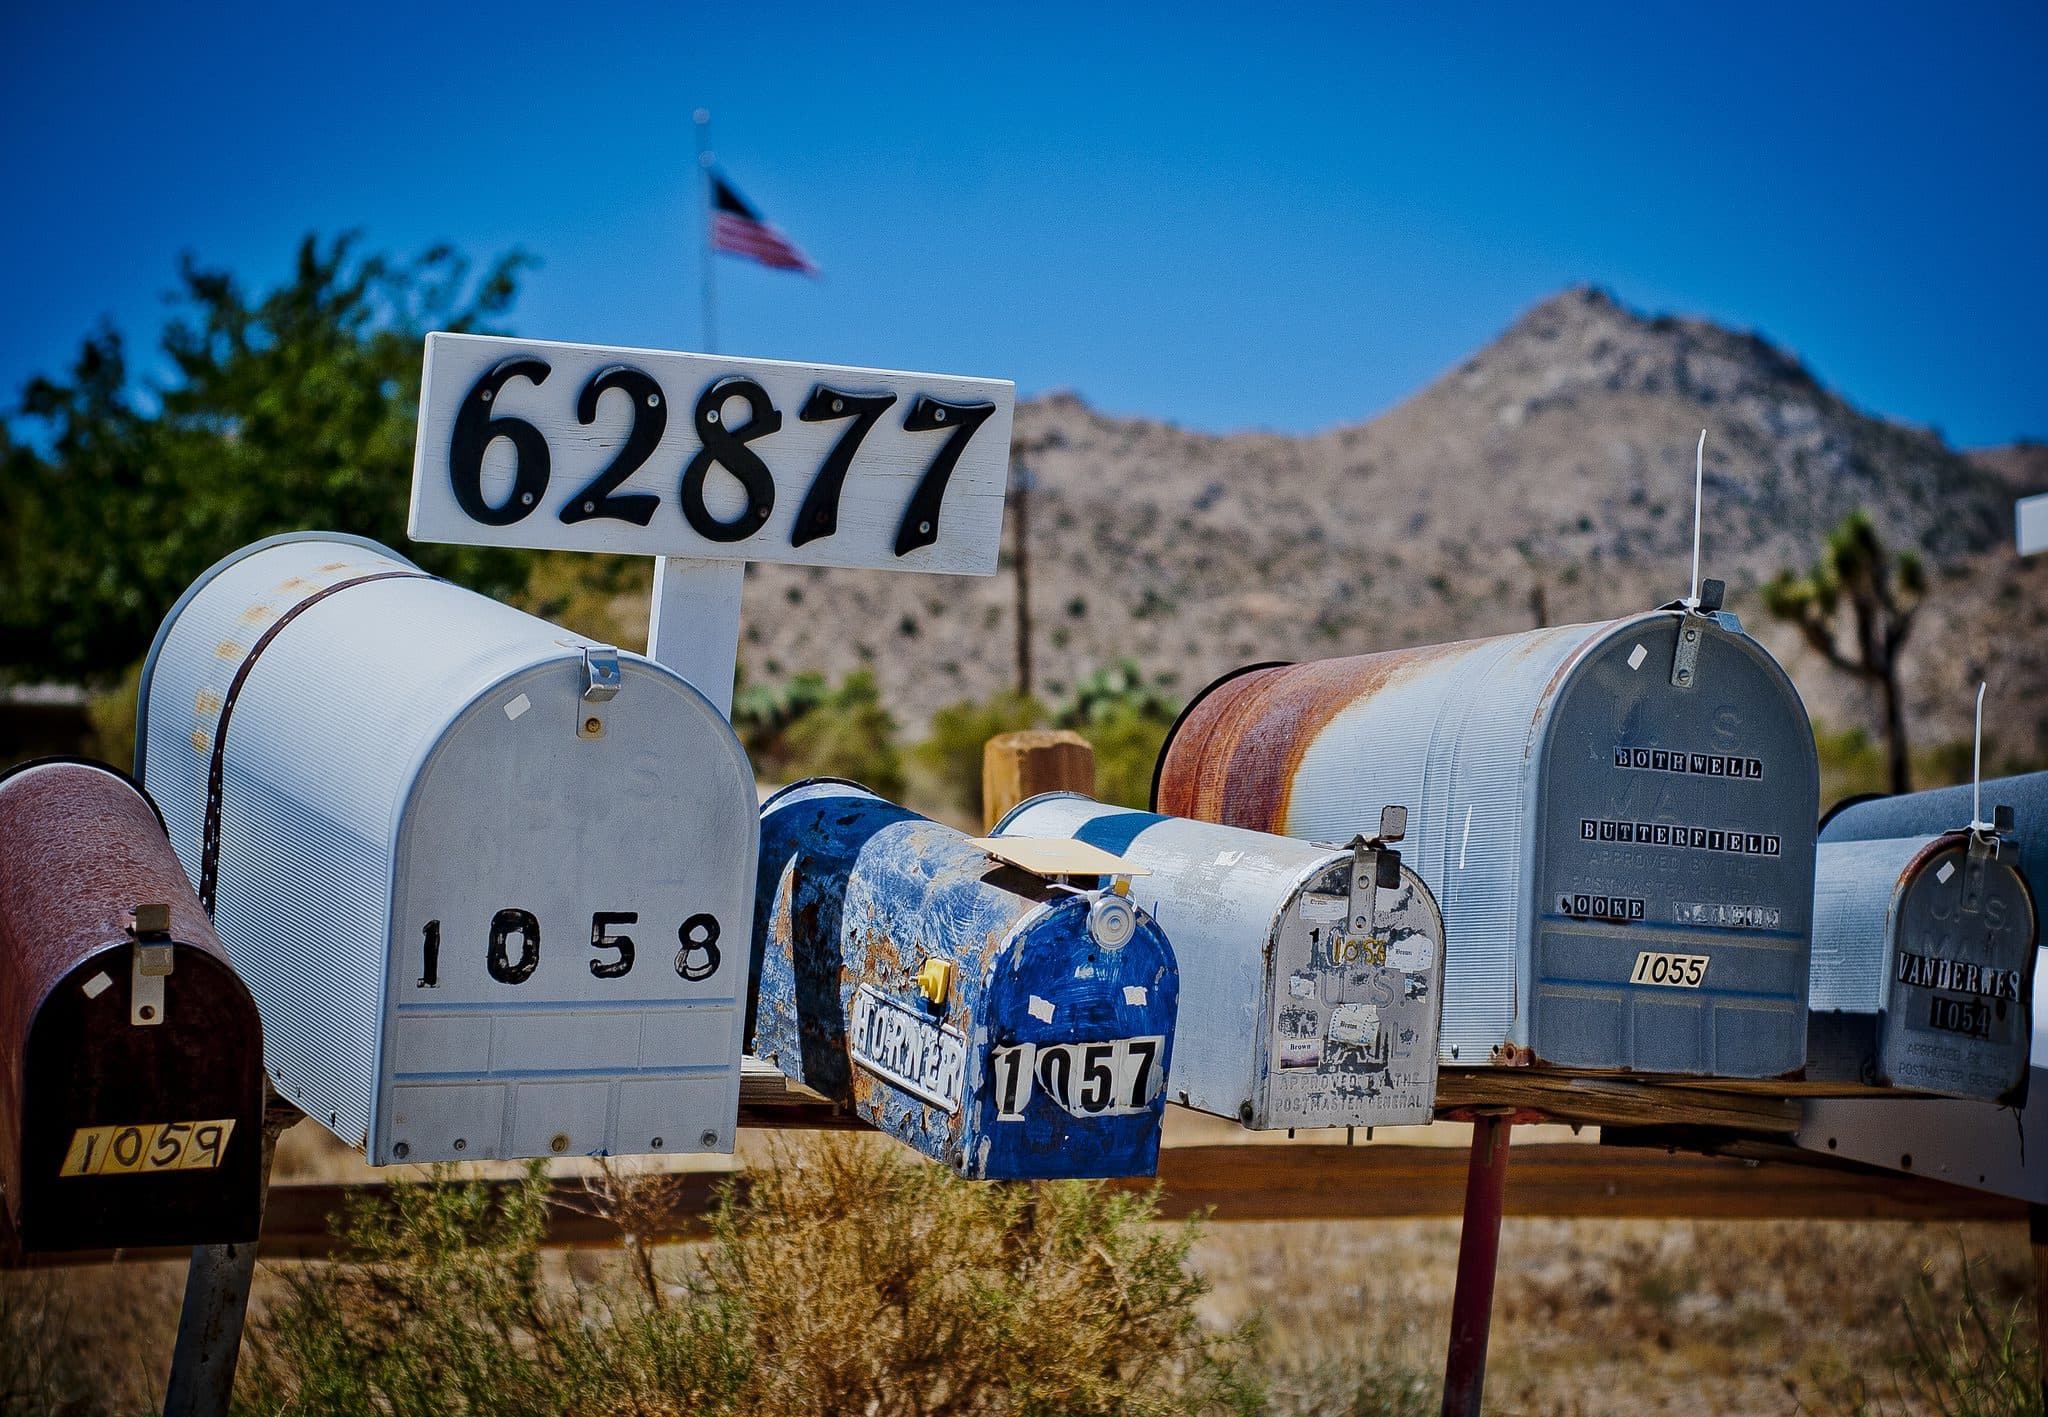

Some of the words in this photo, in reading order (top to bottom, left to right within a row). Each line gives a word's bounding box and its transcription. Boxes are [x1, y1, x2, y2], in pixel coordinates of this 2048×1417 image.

[449, 354, 997, 557] 62877
[1615, 748, 1763, 779] BOTHWELL
[1581, 820, 1781, 856] BUTTERFIELD
[416, 908, 722, 988] 1058
[1637, 954, 1705, 986] 1055
[1935, 999, 1989, 1035] 1054
[853, 994, 961, 1099] HORNER
[1289, 1043, 1311, 1051] Brown
[1001, 1041, 1158, 1118] 1057
[79, 1122, 223, 1172] 1059
